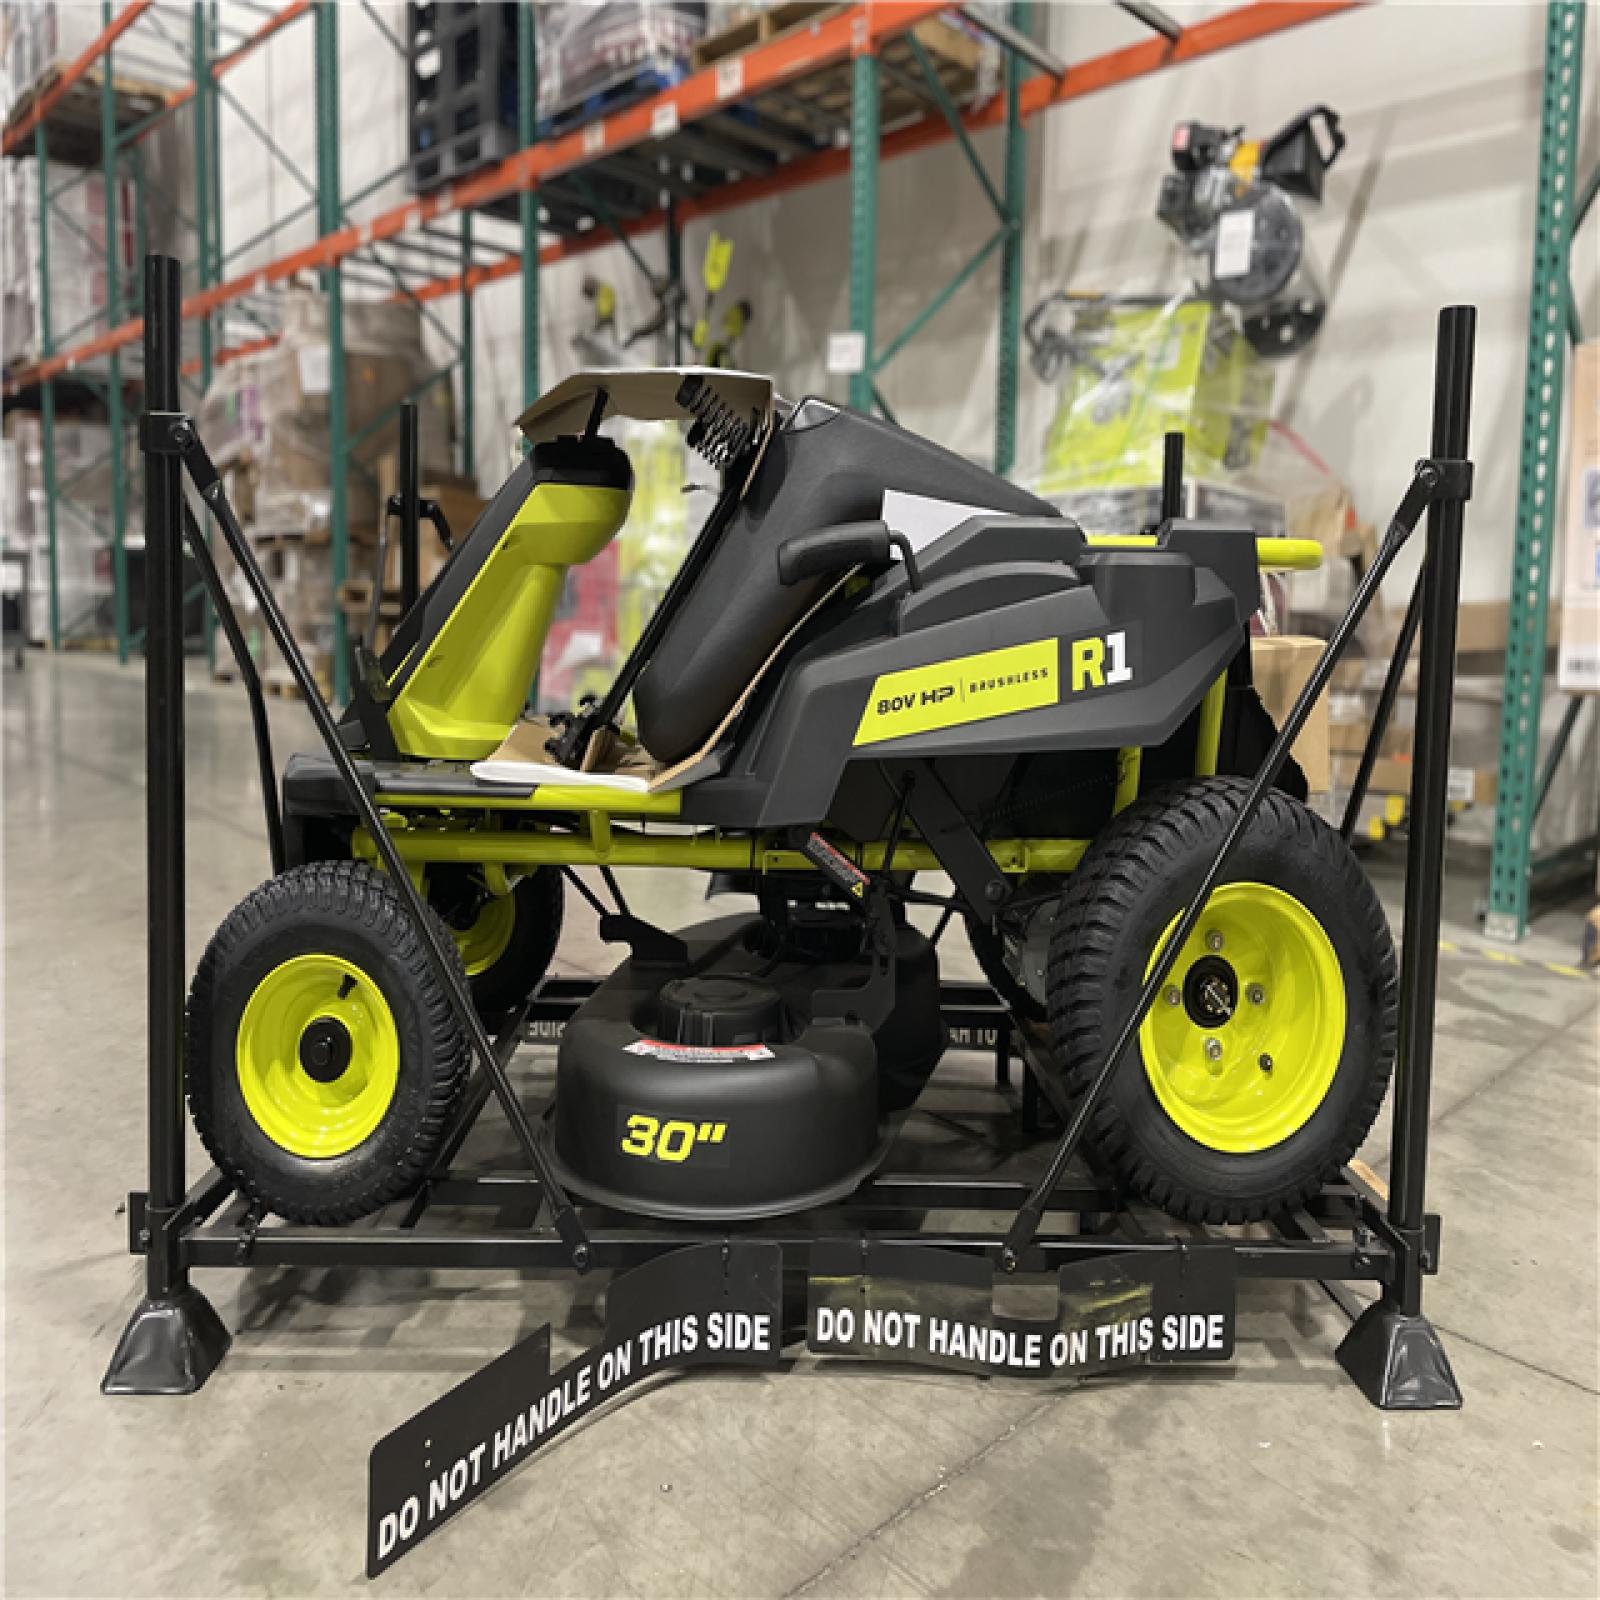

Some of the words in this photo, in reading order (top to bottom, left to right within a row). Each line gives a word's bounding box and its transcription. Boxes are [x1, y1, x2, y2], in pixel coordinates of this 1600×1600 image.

[1072, 631, 1133, 691] R1
[877, 693, 916, 715] 80V
[921, 686, 955, 706] HP
[969, 668, 1049, 693] BRUSHLESS
[621, 1114, 728, 1163] 30"
[818, 1308, 855, 1343] DO
[863, 1310, 920, 1348] NOT
[930, 1316, 1042, 1367] HANDLE
[1050, 1330, 1088, 1366] ON
[1095, 1318, 1153, 1361] THIS
[1162, 1315, 1223, 1350] SIDE
[379, 1495, 421, 1558] DO
[429, 1441, 486, 1521] NOT
[492, 1364, 591, 1470] HANDLE
[598, 1340, 632, 1392] ON
[640, 1315, 698, 1365] THIS
[707, 1313, 770, 1350] SIDE
